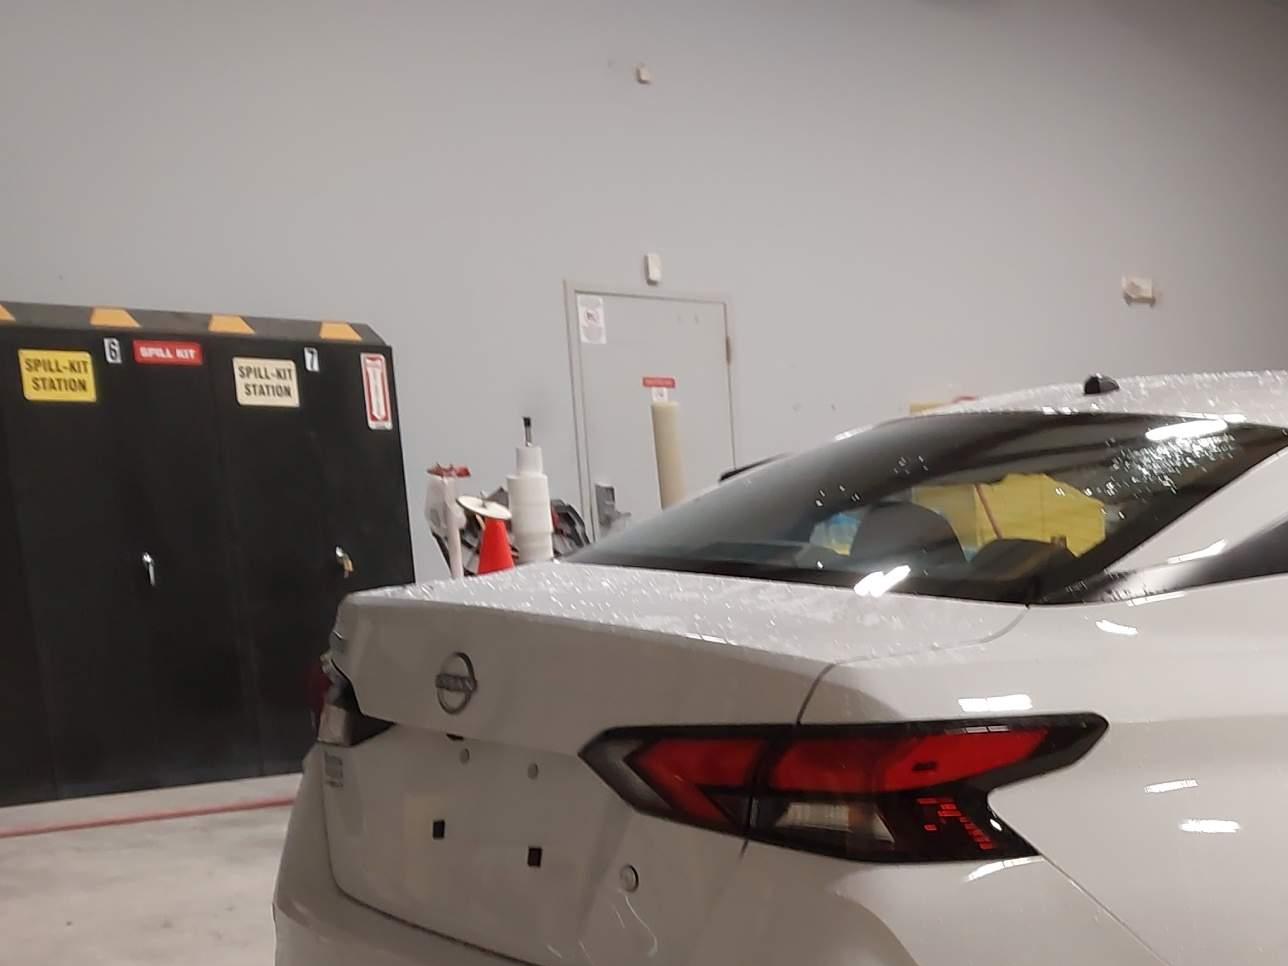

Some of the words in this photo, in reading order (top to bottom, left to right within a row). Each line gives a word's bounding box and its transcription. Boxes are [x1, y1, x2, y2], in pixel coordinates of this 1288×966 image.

[108, 340, 118, 361] 6
[140, 346, 173, 359] SPILL
[175, 348, 196, 360] KIT
[24, 358, 88, 374] SPILL-KIT
[238, 365, 293, 381] SPILL-KIT
[31, 376, 87, 393] STATION
[243, 383, 293, 399] STATION
